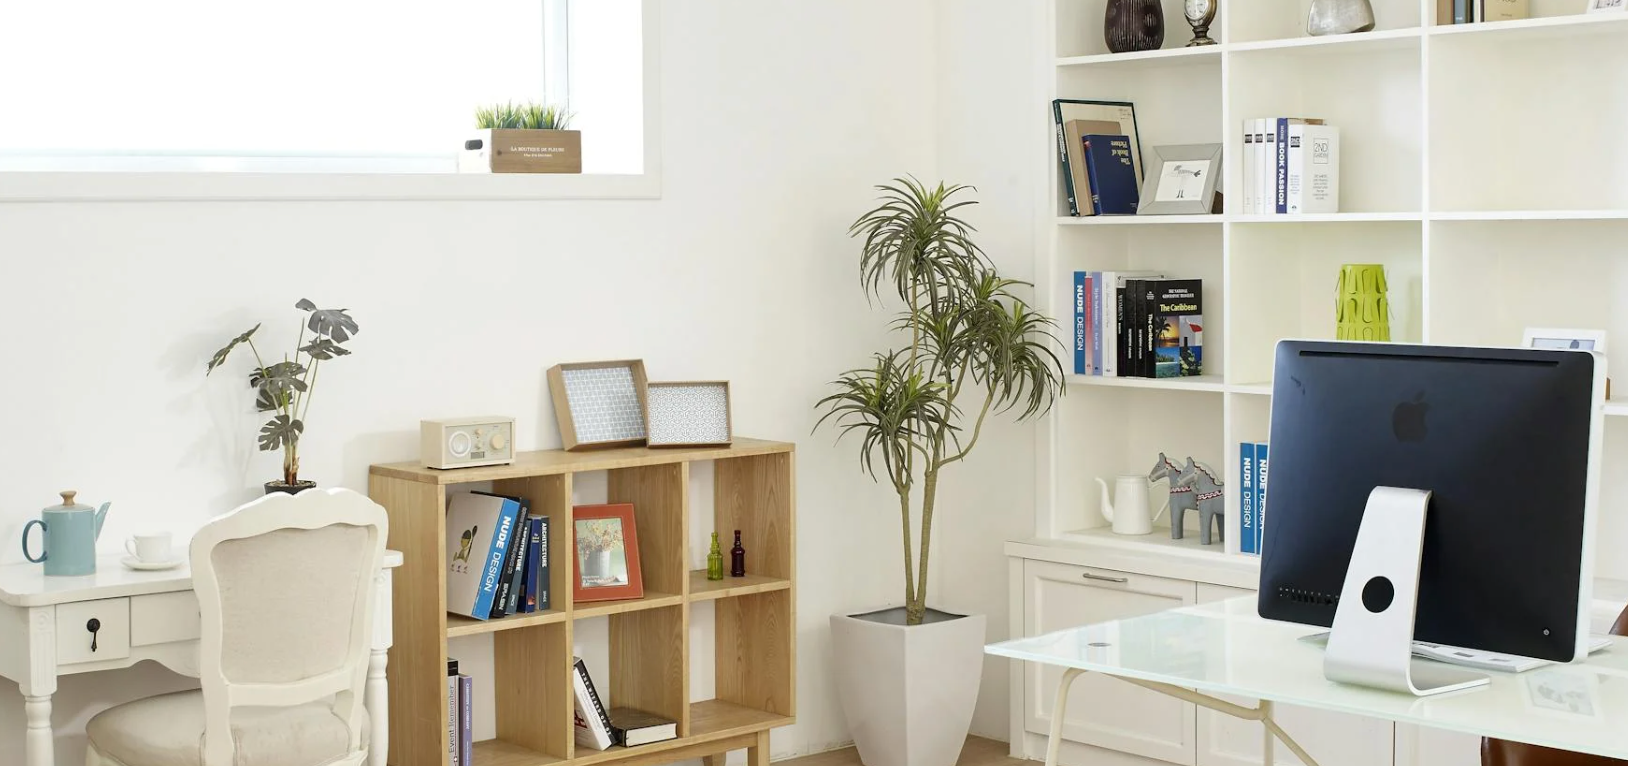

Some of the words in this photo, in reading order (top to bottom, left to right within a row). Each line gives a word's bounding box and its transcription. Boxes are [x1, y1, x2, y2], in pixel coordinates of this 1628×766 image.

[1160, 304, 1170, 312] The
[1170, 303, 1197, 312] Caribbean
[1076, 316, 1084, 351] DESIGN
[1243, 457, 1251, 488] NUDE
[1259, 459, 1267, 489] NUDE
[1243, 491, 1251, 528] DESIGN
[496, 515, 511, 549] NUDE
[484, 551, 501, 592] DESIGN
